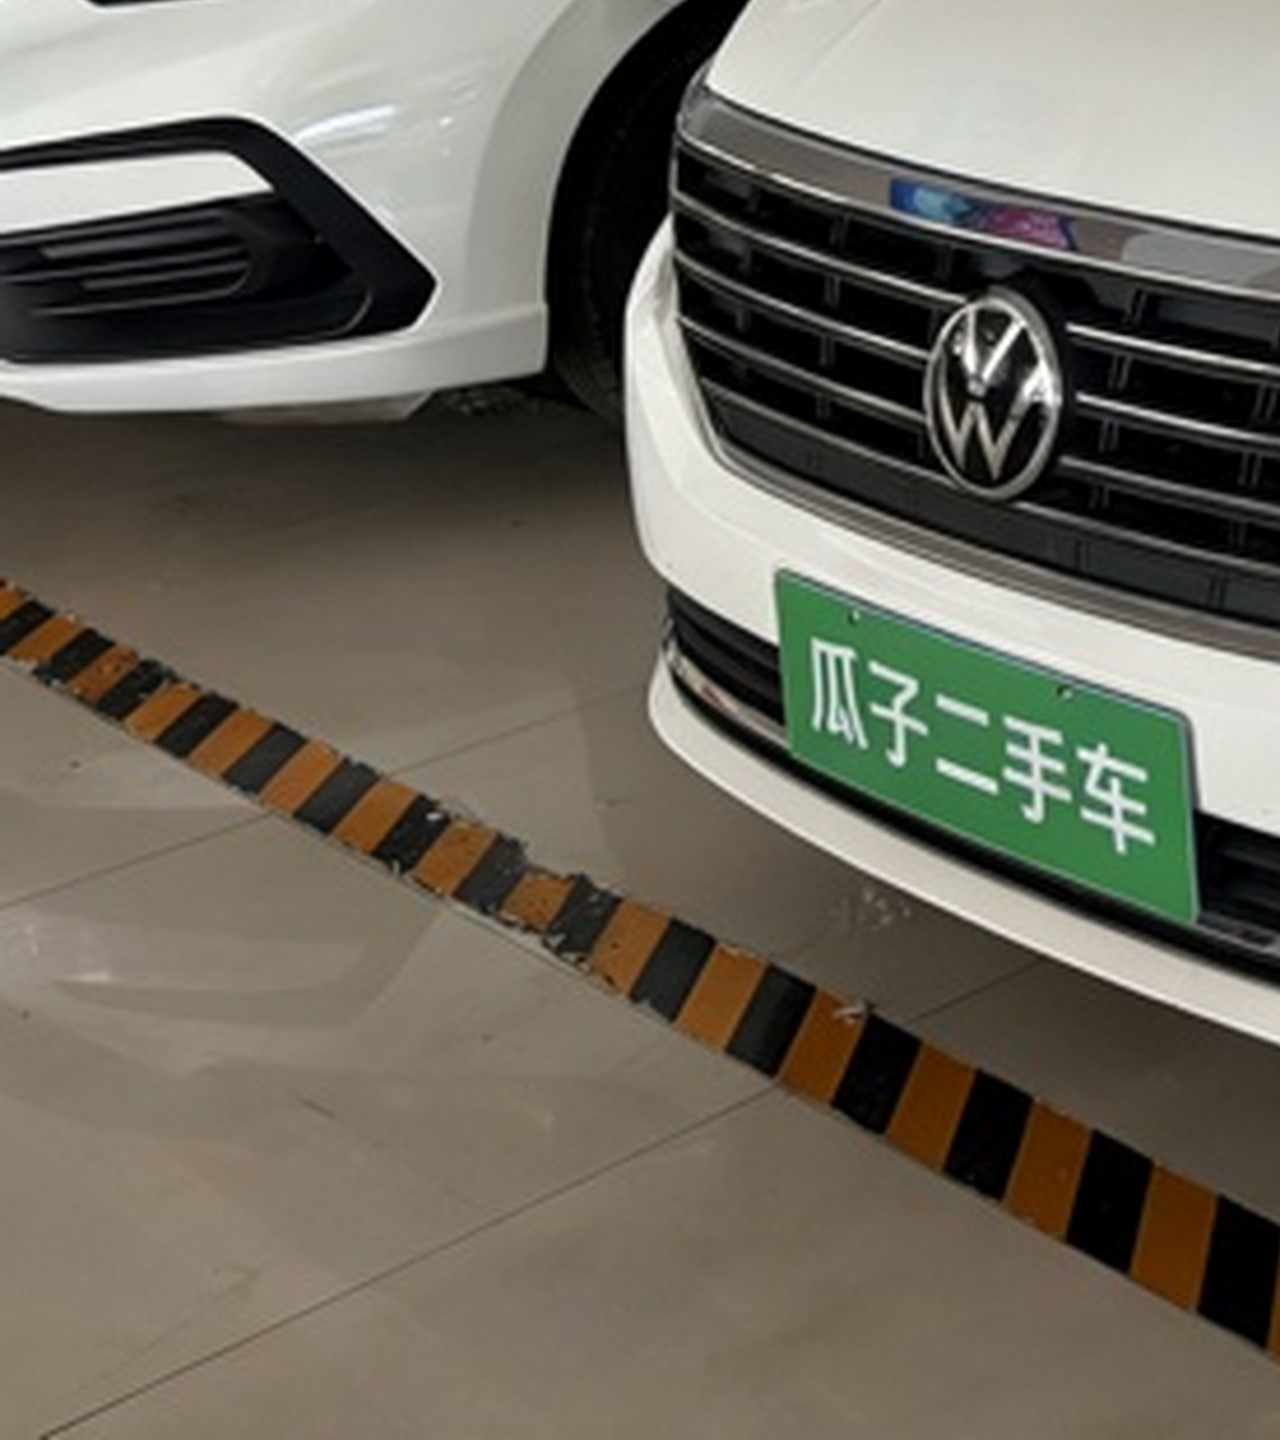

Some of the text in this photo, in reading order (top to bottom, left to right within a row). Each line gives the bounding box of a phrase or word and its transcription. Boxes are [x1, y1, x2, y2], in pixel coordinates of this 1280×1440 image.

[810, 636, 1156, 856] 瓜子二手车
